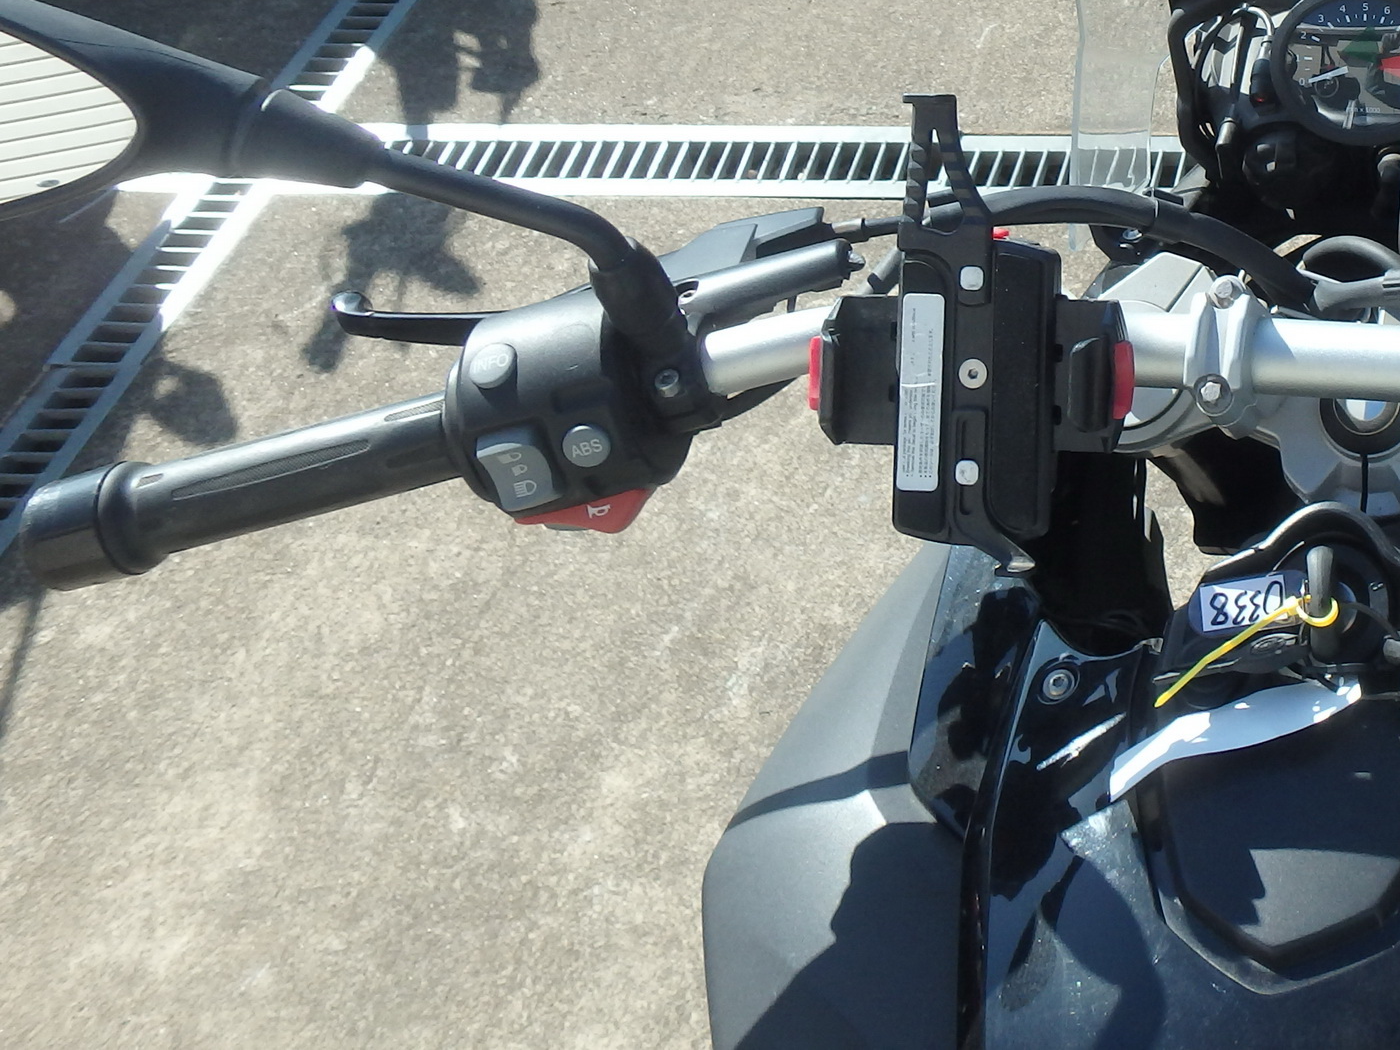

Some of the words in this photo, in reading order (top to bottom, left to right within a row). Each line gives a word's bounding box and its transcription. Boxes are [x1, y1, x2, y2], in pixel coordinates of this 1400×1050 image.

[1339, 4, 1347, 13] 4
[1362, 3, 1369, 12] 5
[1384, 6, 1391, 14] 6
[1318, 14, 1325, 23] 3
[1299, 78, 1305, 86] 0
[473, 353, 509, 373] INFO
[571, 438, 603, 458] ABS
[1209, 580, 1284, 626] 0338
